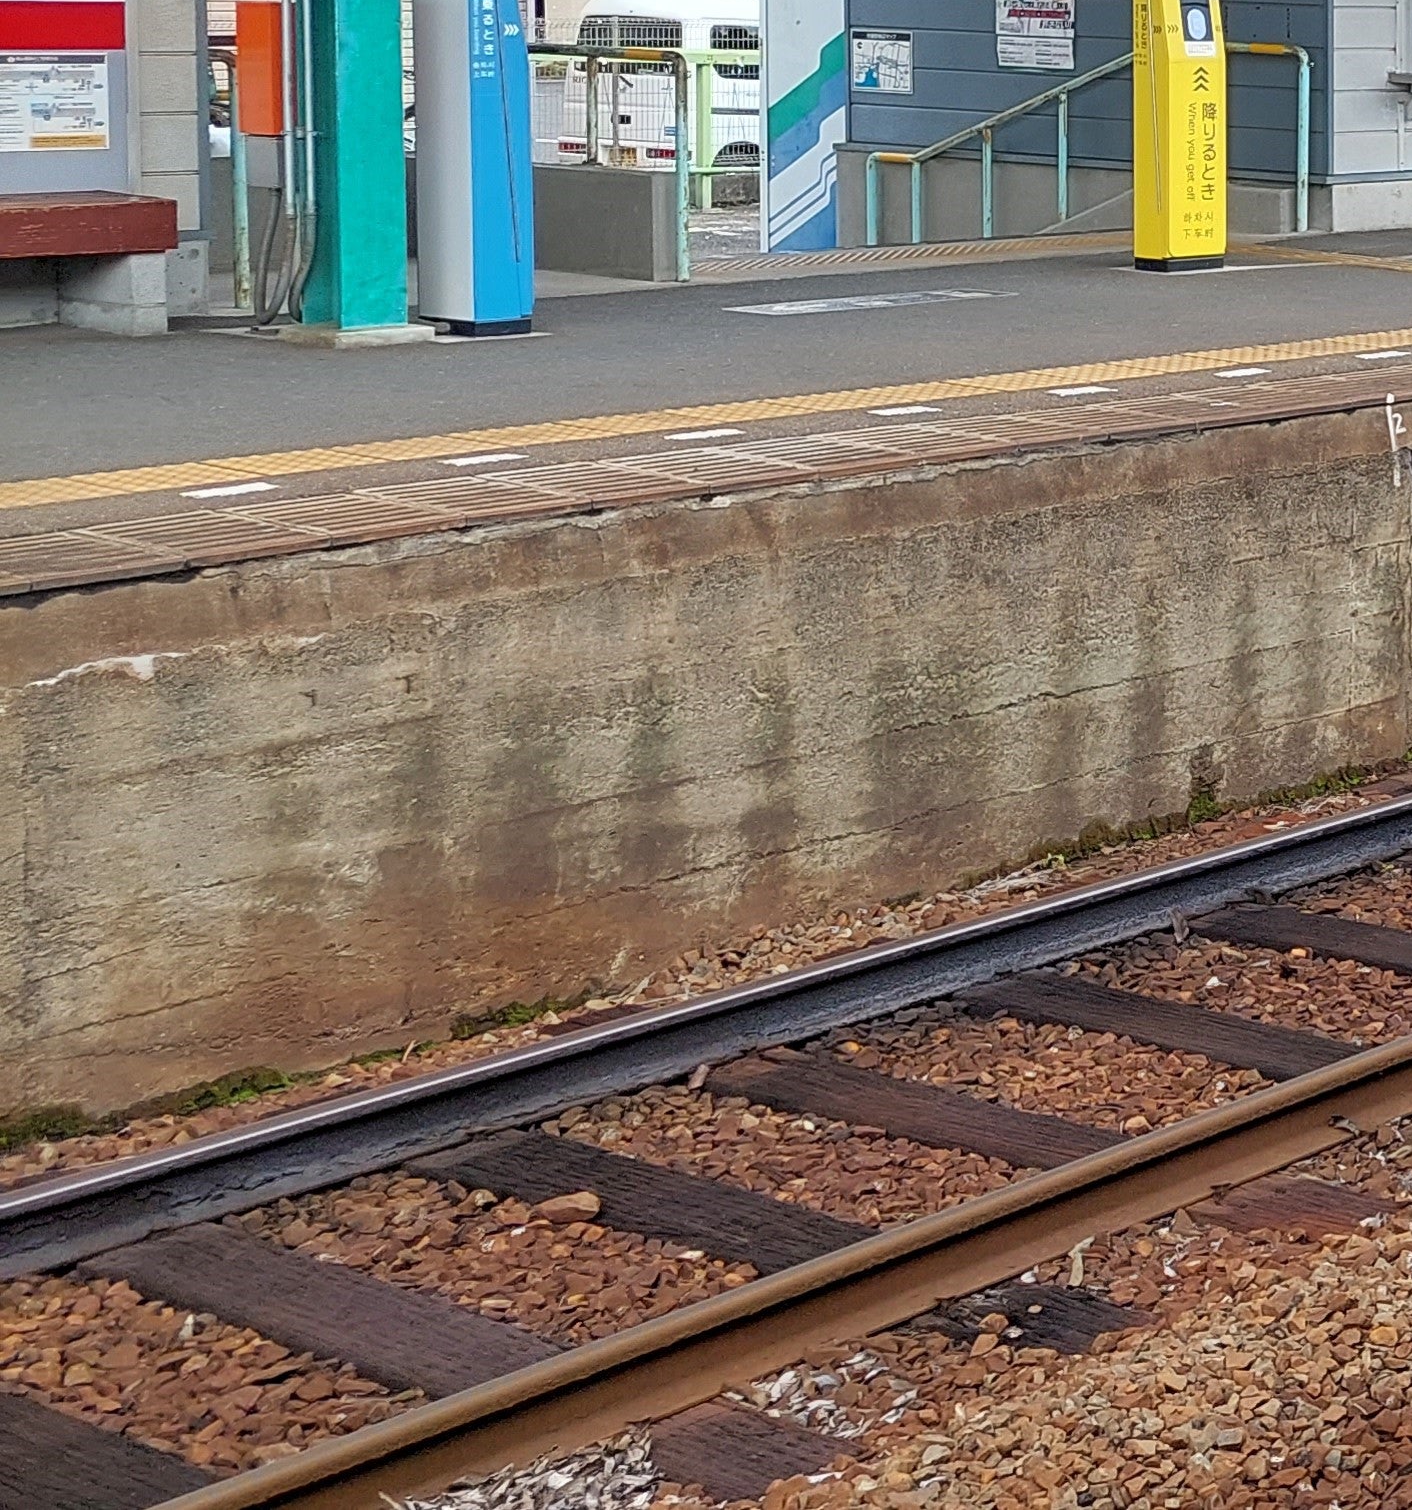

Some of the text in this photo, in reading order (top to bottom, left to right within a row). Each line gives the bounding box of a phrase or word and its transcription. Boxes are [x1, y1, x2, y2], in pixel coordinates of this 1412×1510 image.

[1187, 102, 1198, 136] When
[1187, 139, 1197, 161] you
[1202, 101, 1218, 201] 降りるとき
[1186, 165, 1196, 183] get
[1391, 412, 1408, 435] 2
